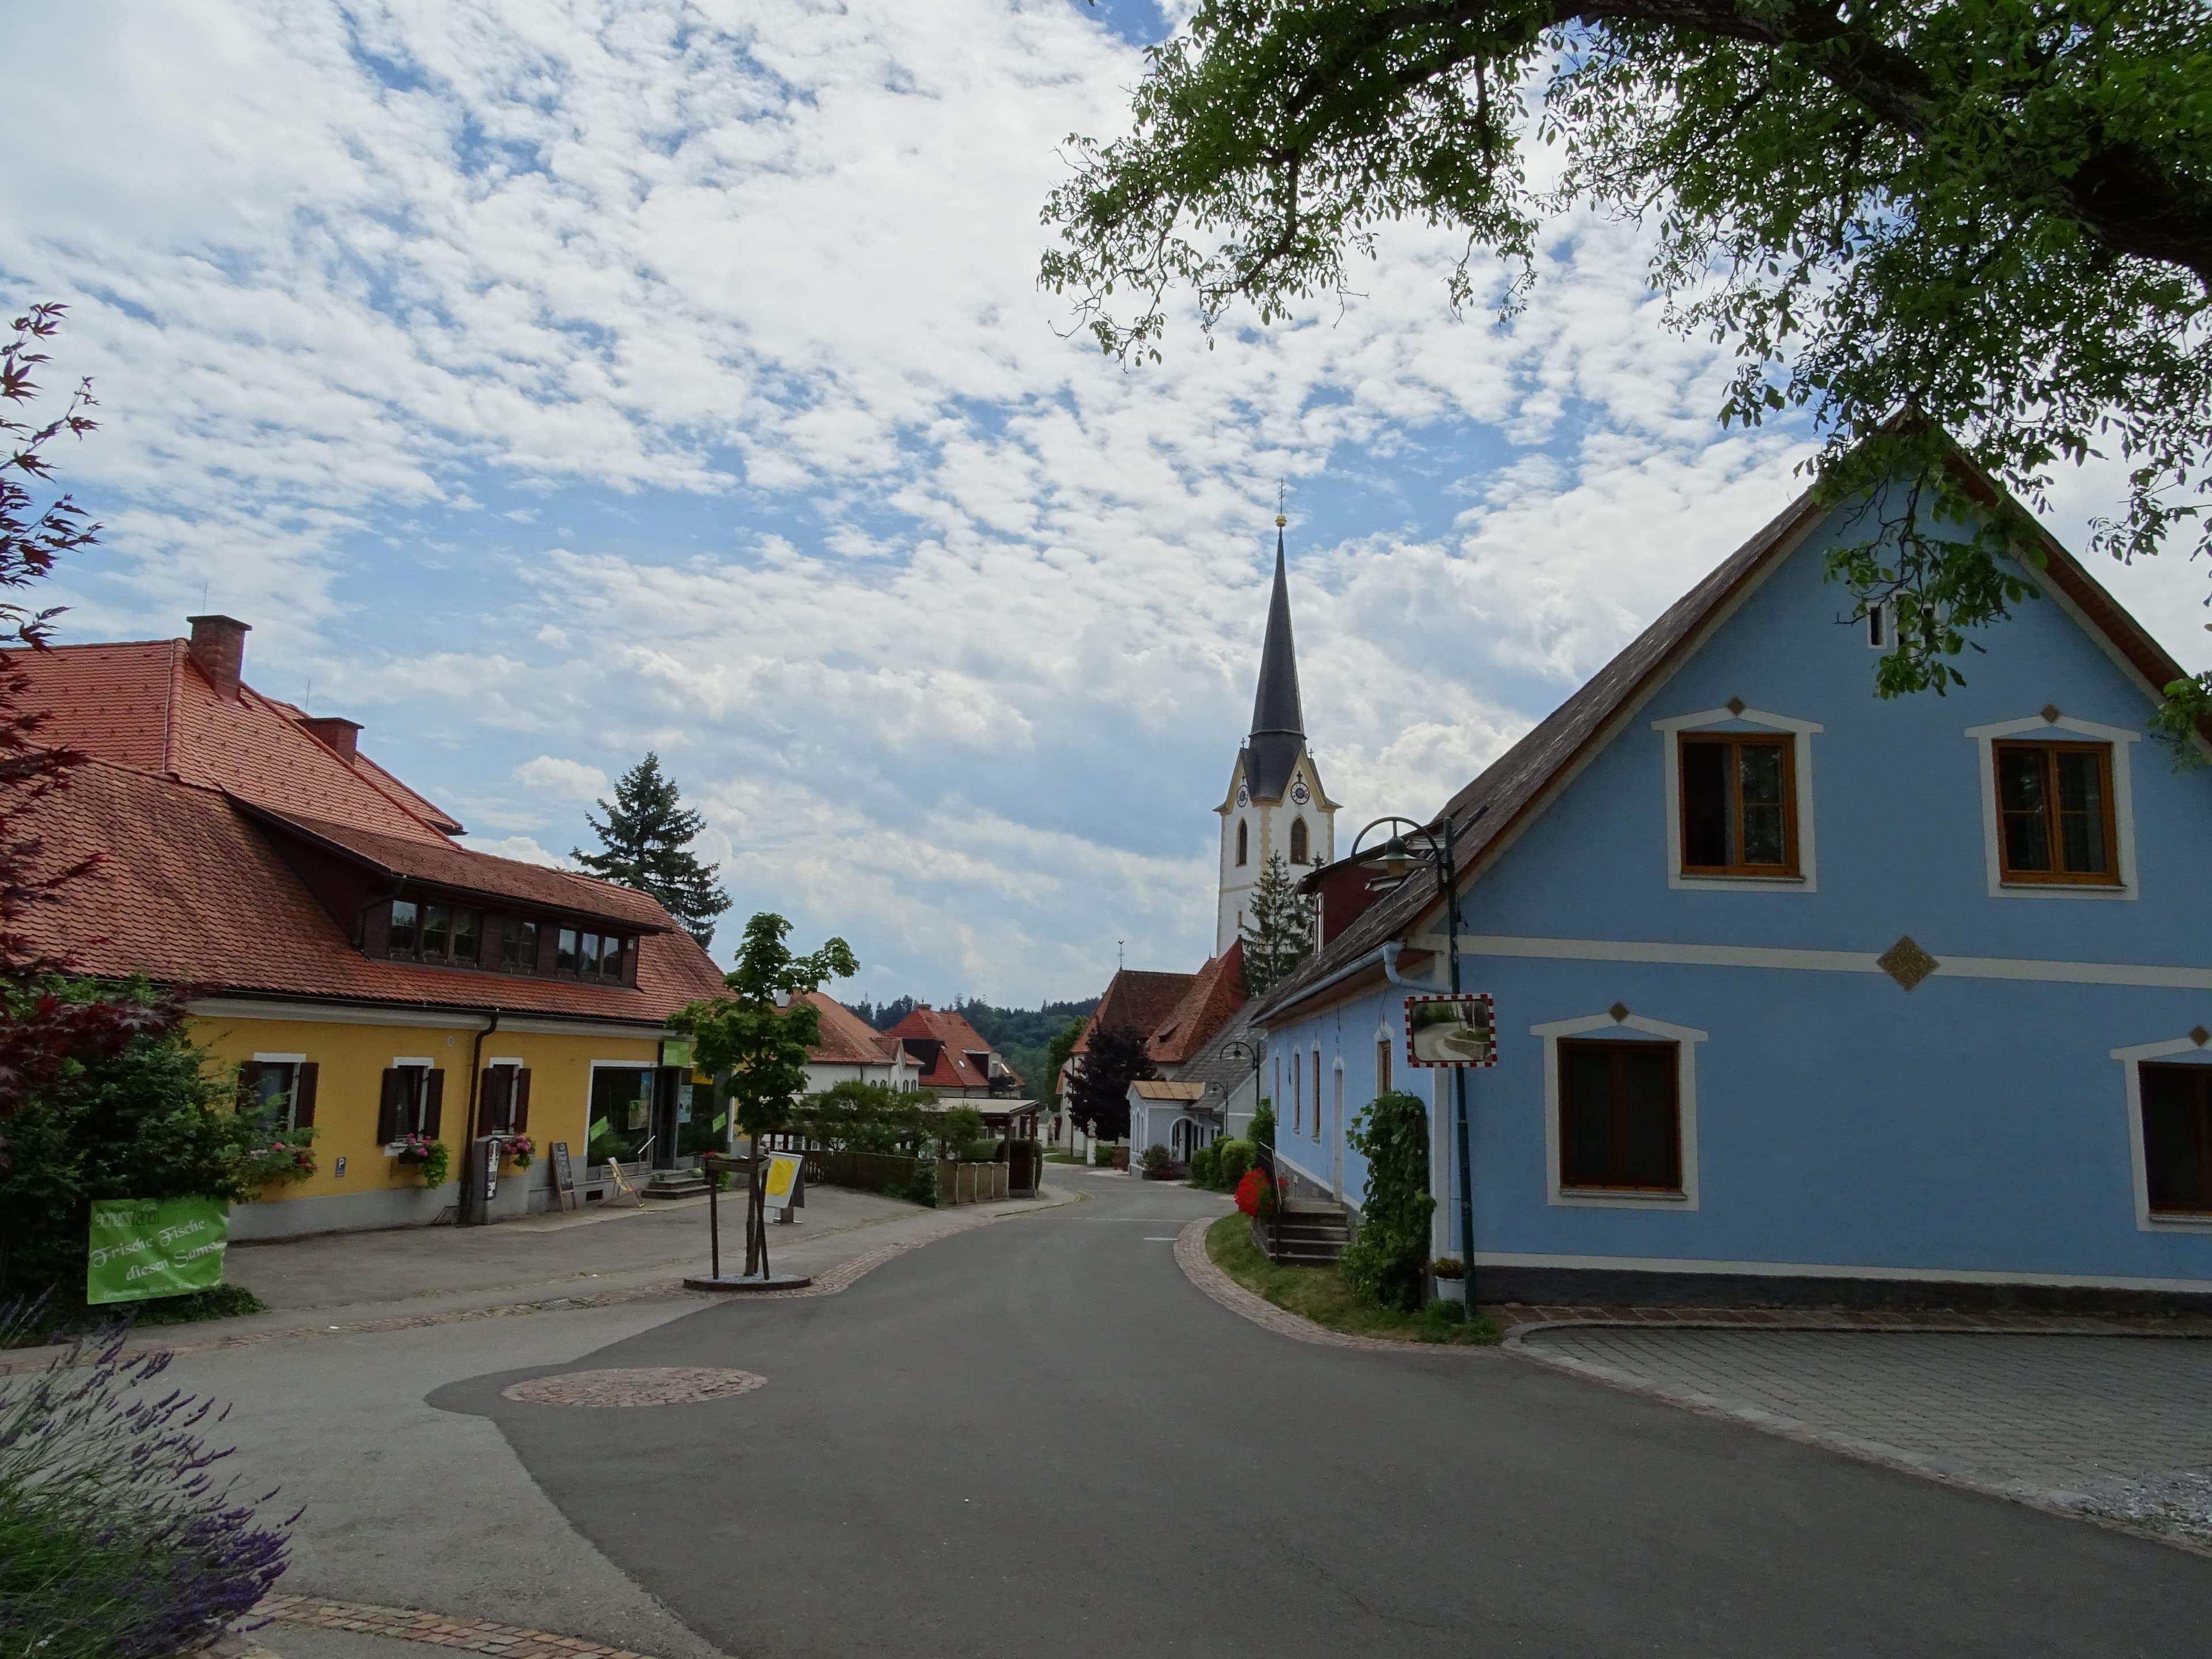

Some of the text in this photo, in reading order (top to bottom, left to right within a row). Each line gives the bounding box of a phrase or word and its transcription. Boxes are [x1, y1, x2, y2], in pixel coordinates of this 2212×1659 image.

[339, 1158, 344, 1168] P
[90, 1219, 206, 1268] Frische Fische
[126, 1241, 228, 1281] diesen Sams
